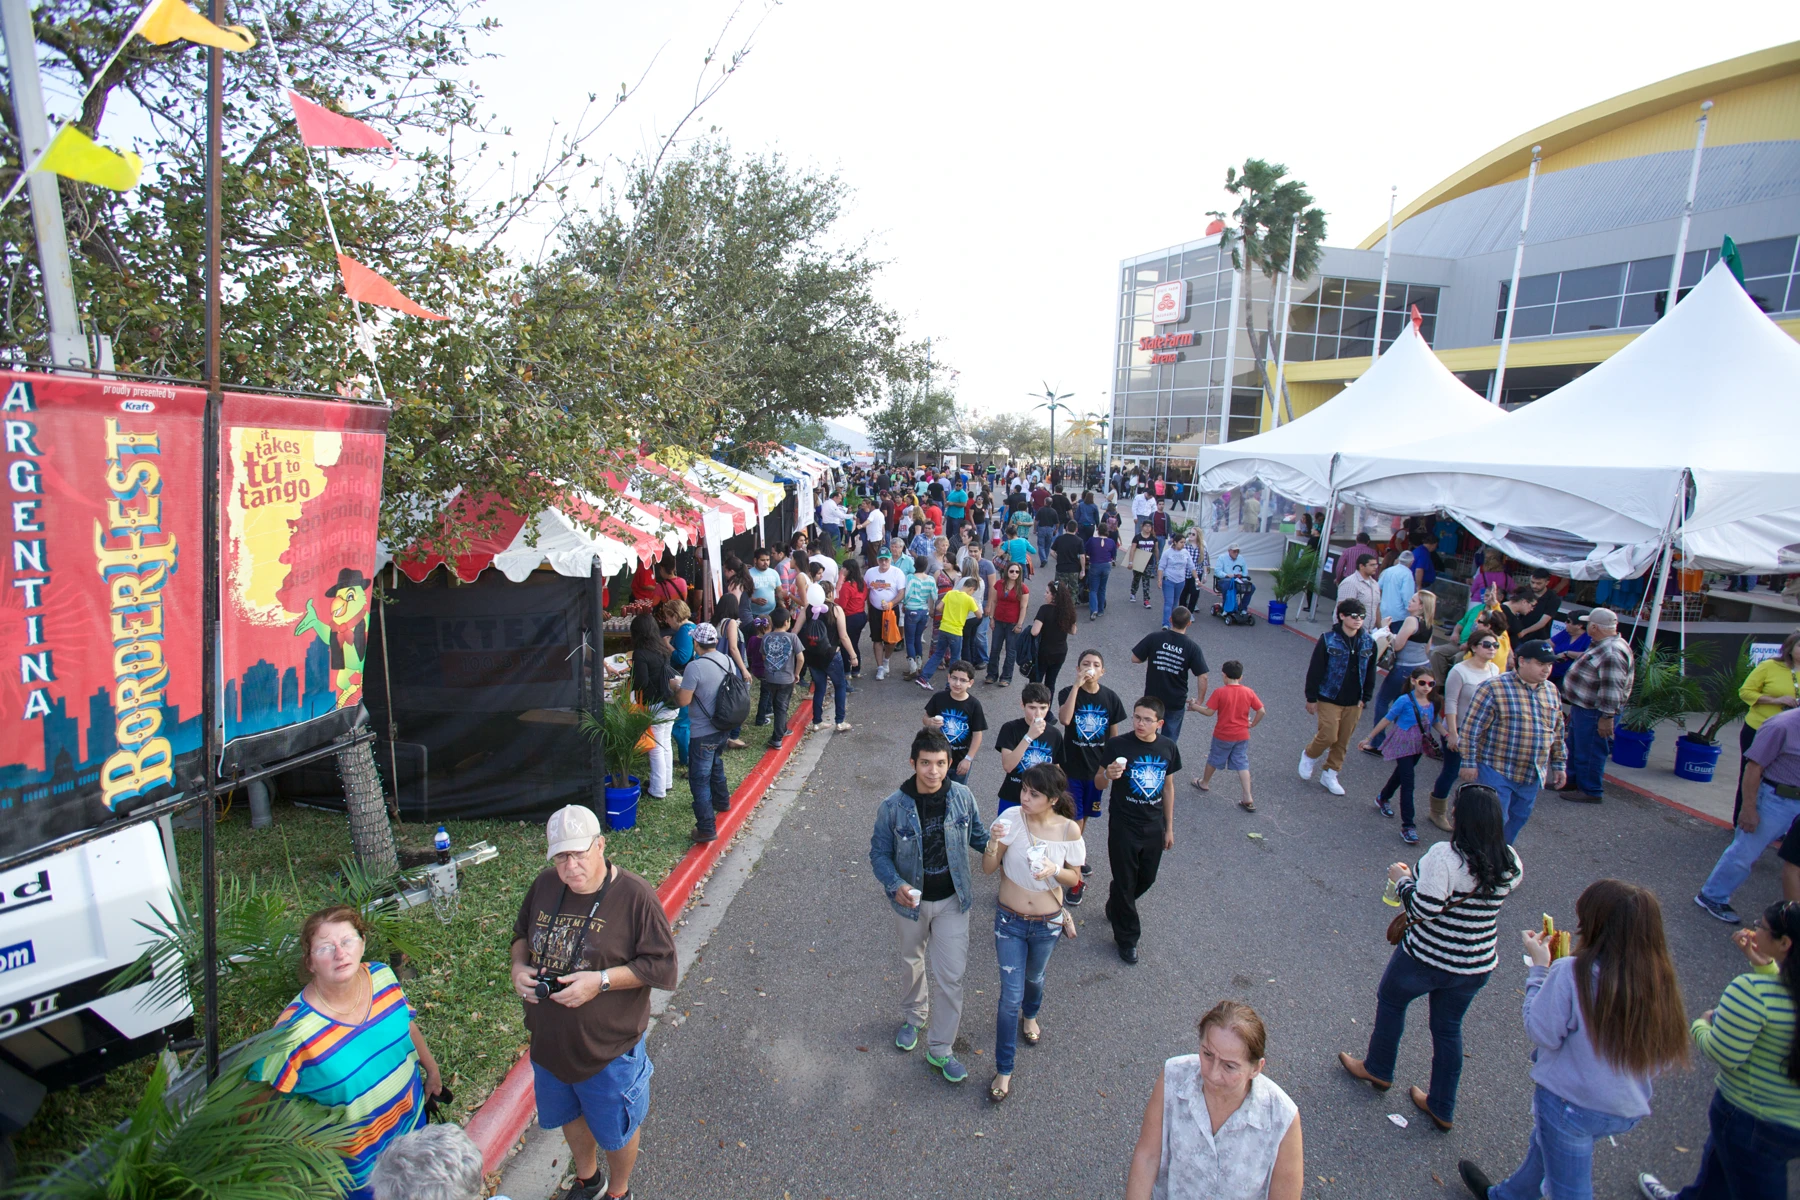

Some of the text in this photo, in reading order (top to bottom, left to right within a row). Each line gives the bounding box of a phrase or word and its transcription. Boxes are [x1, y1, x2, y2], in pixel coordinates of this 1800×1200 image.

[1150, 353, 1177, 365] Arena
[103, 384, 177, 400] proudly presented by
[125, 402, 150, 411] Kraft
[260, 430, 270, 441] it
[255, 437, 300, 459] takes
[243, 451, 300, 488] tú to
[238, 479, 310, 510] tango
[2, 381, 58, 720] ARGENTINA
[441, 615, 561, 649] KTEX
[1162, 642, 1184, 655] CASAS
[520, 653, 548, 667] FM
[537, 910, 604, 933] DEARTMNT
